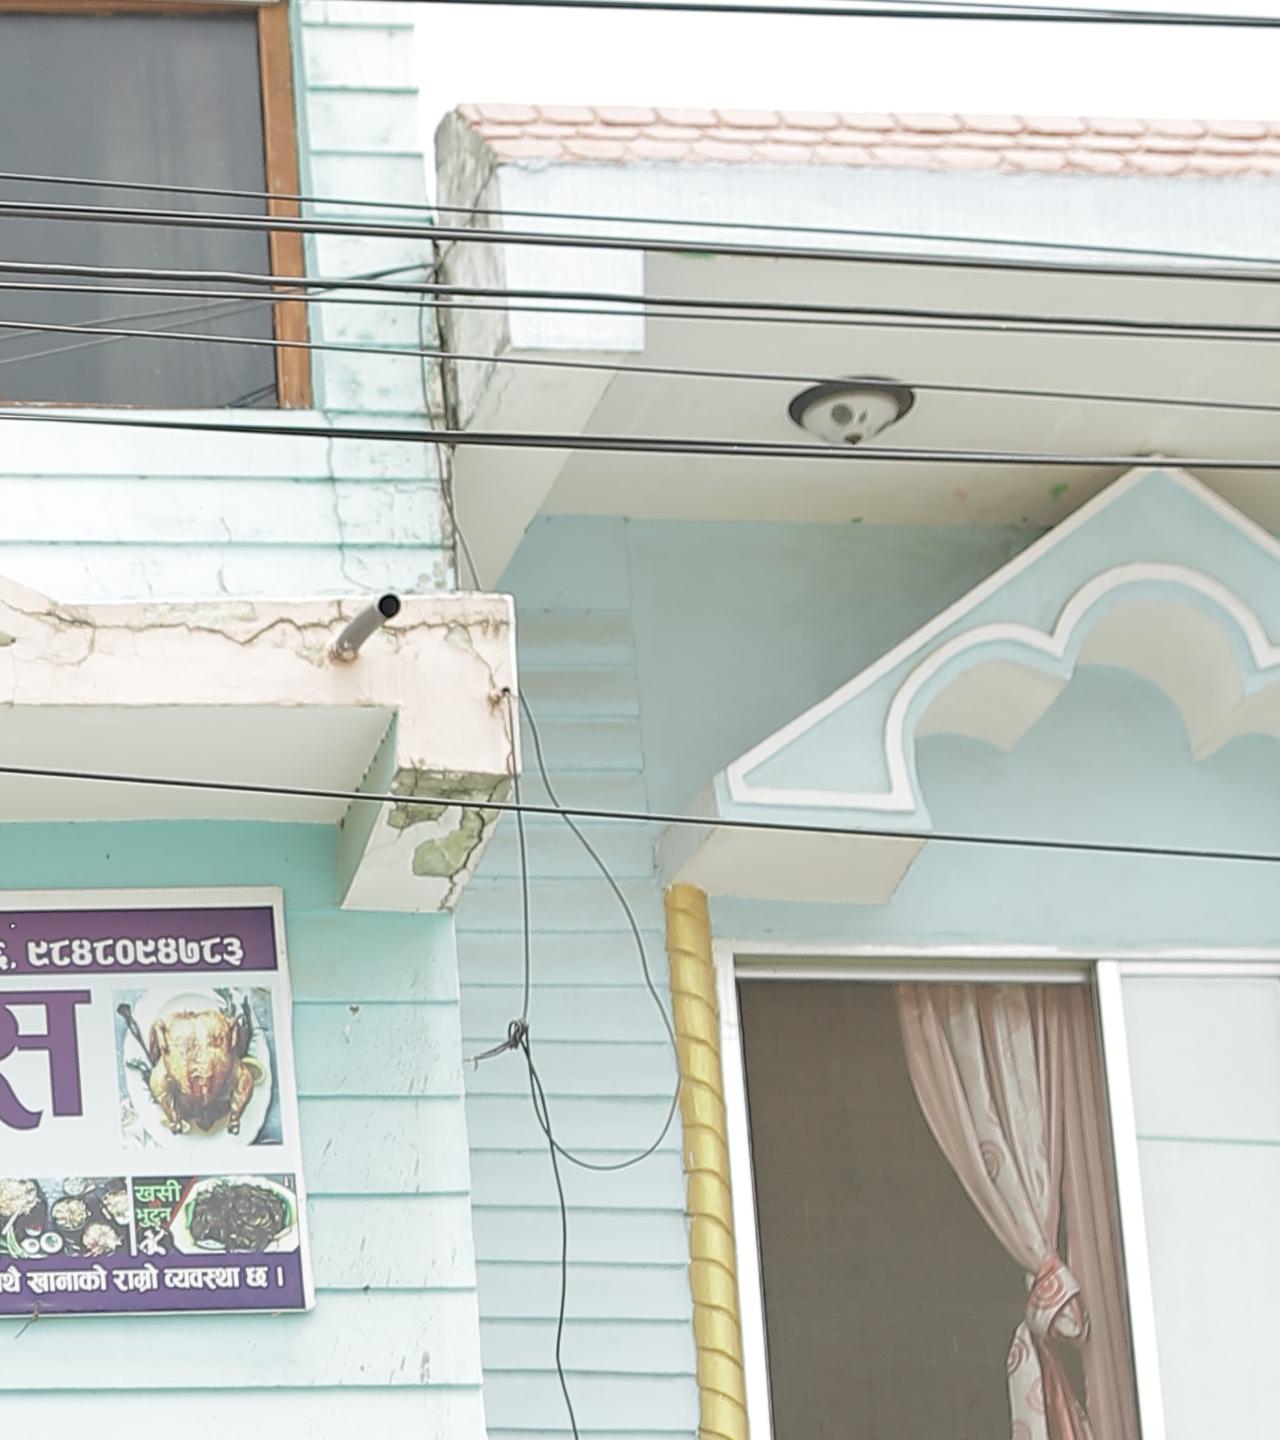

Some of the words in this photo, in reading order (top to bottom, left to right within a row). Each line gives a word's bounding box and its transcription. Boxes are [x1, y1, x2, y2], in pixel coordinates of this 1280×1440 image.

[28, 937, 243, 966] ९८४८०९४७८३
[133, 1179, 183, 1204] खसी
[26, 1264, 107, 1293] खानाको
[112, 1263, 159, 1292] राम्रो
[164, 1267, 240, 1289] व्यवस्था
[245, 1266, 268, 1287] छ
